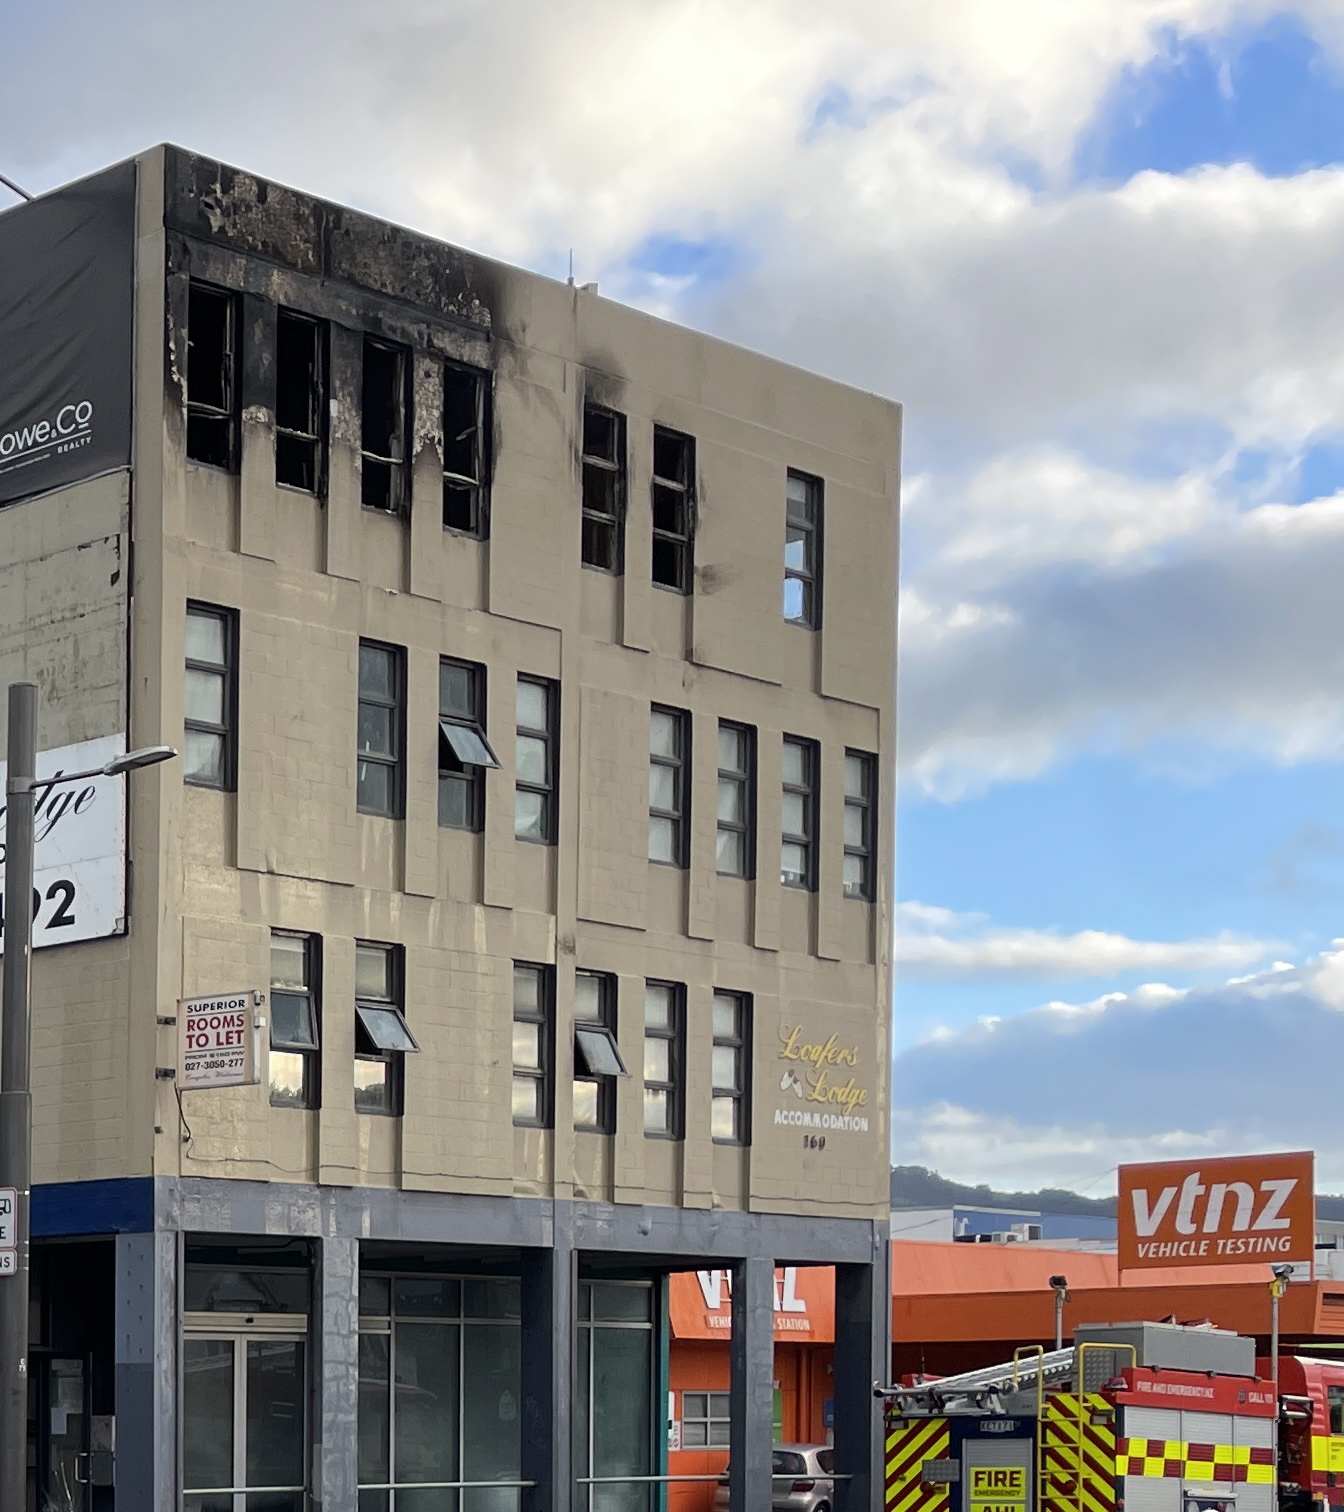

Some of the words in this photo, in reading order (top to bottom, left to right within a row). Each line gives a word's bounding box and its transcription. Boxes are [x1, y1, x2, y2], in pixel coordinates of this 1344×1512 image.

[57, 436, 92, 454] REALTY
[187, 999, 245, 1014] SUPERIOR
[187, 1014, 244, 1032] ROOMS
[185, 1032, 209, 1049] TO
[215, 1030, 244, 1047] LET
[777, 1023, 859, 1069] Loafers
[805, 1067, 869, 1115] Lodge
[774, 1109, 869, 1132] ACCOMMODATION
[1131, 1171, 1299, 1237] vtnz
[1137, 1240, 1210, 1259] VEHICLE
[1217, 1235, 1291, 1255] TESTING
[777, 1317, 810, 1331] STATION
[974, 1470, 1021, 1488] FIRE
